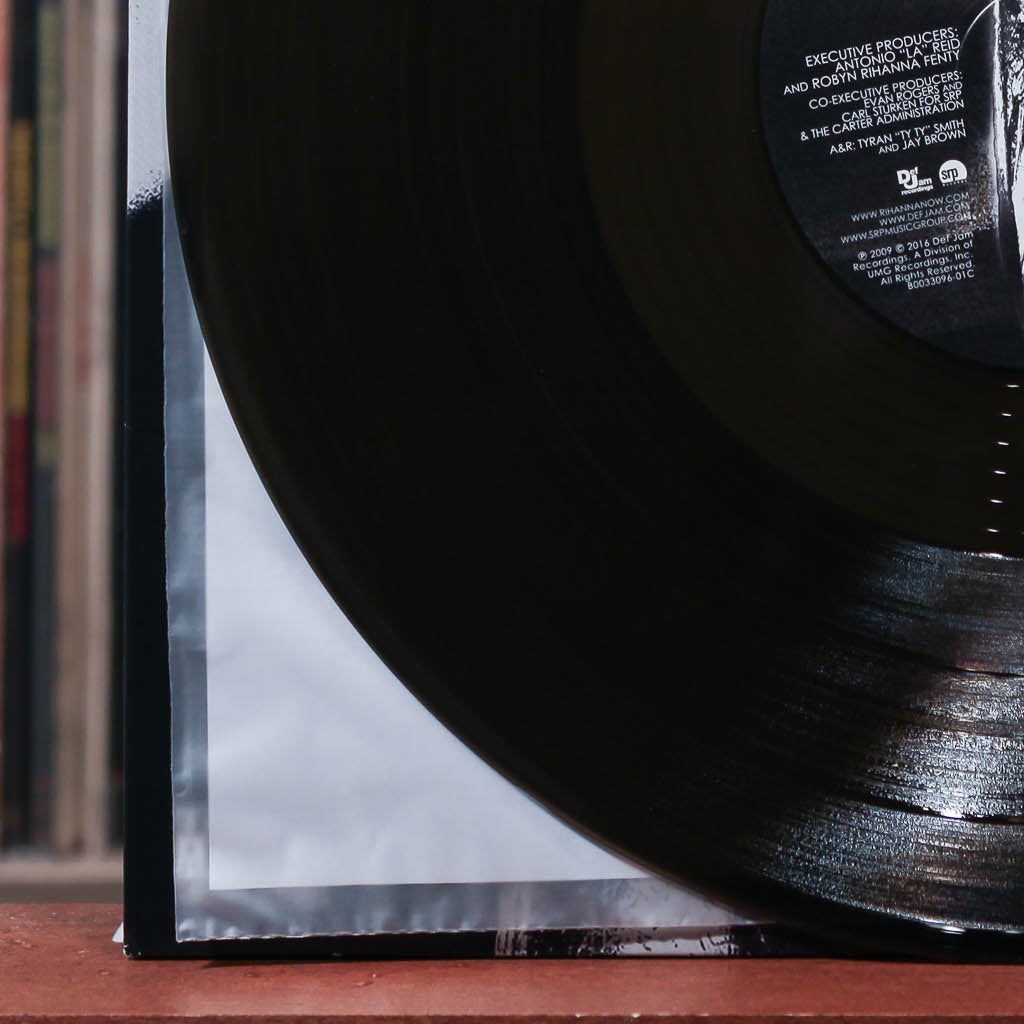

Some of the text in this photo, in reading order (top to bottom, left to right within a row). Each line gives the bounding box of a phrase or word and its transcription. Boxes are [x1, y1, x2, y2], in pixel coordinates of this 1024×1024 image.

[805, 26, 959, 68] EXECUTIVE PRODUCERS:
[835, 51, 896, 73] ANTONIO
[932, 38, 961, 54] REID
[783, 49, 960, 96] AND ROBYN RIHANNA FENTY
[808, 70, 963, 110] CO-EXECUTIVE PRODUCERS:
[863, 81, 963, 109] EVAN ROGERS AND
[800, 99, 965, 141] & THE CARTER ADMINISTRATION
[841, 90, 963, 123] CARL STURKEN FOR SRP
[829, 141, 857, 156] A&R:
[857, 134, 893, 149] TYRAN
[933, 118, 965, 134] SMITH
[878, 128, 967, 155] AND JAY BROWN
[851, 191, 970, 223] WWW.RIHANNANOW.COM
[879, 202, 970, 227] WWW.DEFJAM.COM
[869, 247, 893, 260] 2009
[907, 239, 930, 251] 2016
[932, 233, 950, 246] Def
[953, 230, 974, 242] Jam
[914, 251, 921, 260] A
[924, 243, 961, 258] Division
[963, 239, 974, 249] of
[867, 266, 892, 279] UMG
[954, 251, 974, 262] Inc.
[880, 277, 893, 286] All
[895, 269, 925, 284] Rights
